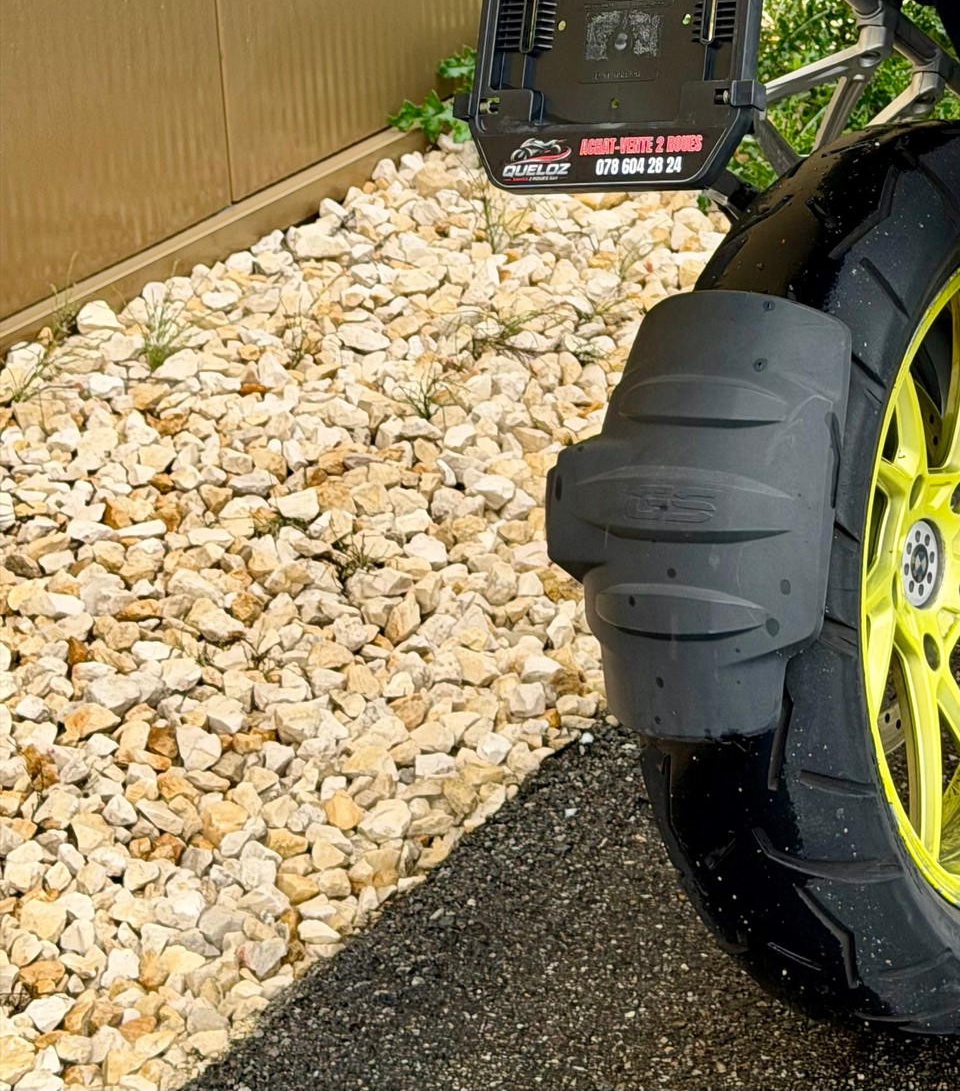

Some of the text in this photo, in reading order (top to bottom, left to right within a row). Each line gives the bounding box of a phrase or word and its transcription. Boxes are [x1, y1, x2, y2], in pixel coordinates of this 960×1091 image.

[579, 134, 703, 155] ACHAT-VENTE 2 ROUES
[502, 163, 571, 177] QUELOZ
[595, 156, 682, 176] 078 604 28 24
[623, 484, 716, 524] GS
